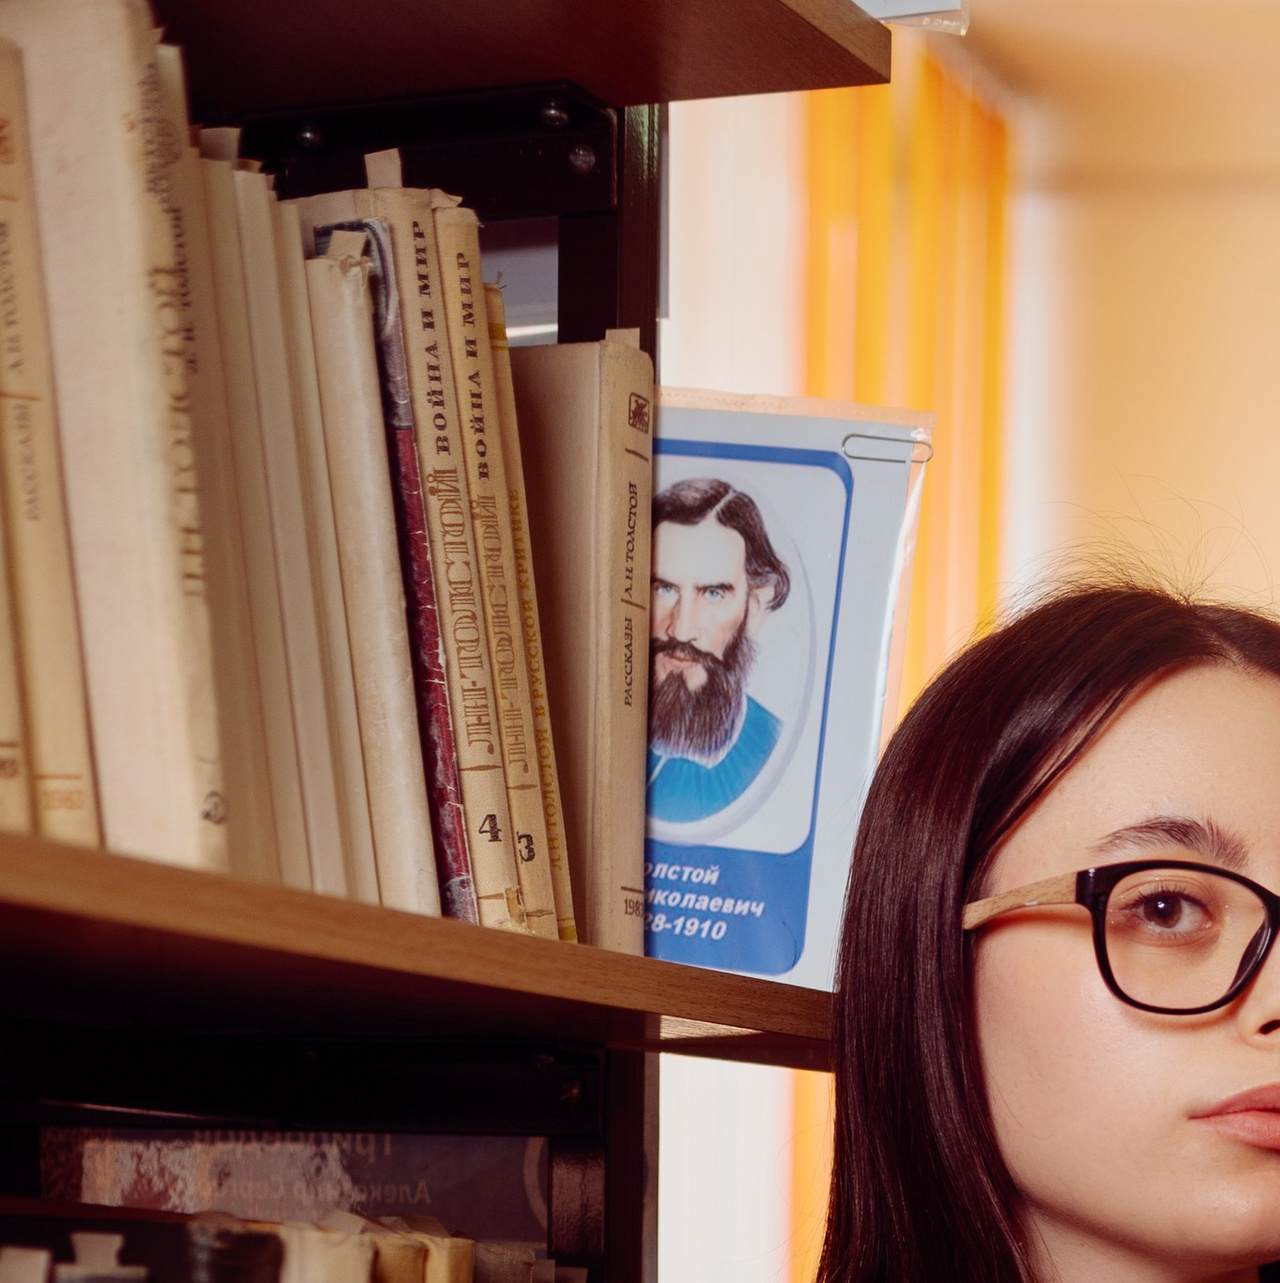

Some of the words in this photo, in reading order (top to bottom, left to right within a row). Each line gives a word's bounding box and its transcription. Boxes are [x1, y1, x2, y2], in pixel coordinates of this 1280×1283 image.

[412, 221, 432, 299] МИР
[456, 251, 475, 327] МИР
[420, 307, 435, 332] И
[464, 336, 478, 359] И
[425, 340, 451, 456] ВОЙНА
[467, 369, 490, 481] ВОЙНА
[509, 488, 532, 591] КРИТИКЕ
[624, 481, 638, 563] ТОЛСТОЙ
[523, 599, 545, 701] РУССКОЙ
[623, 616, 634, 708] РАССКАЗЫ
[533, 704, 546, 718] В
[478, 813, 503, 842] 4
[515, 831, 536, 864] 3
